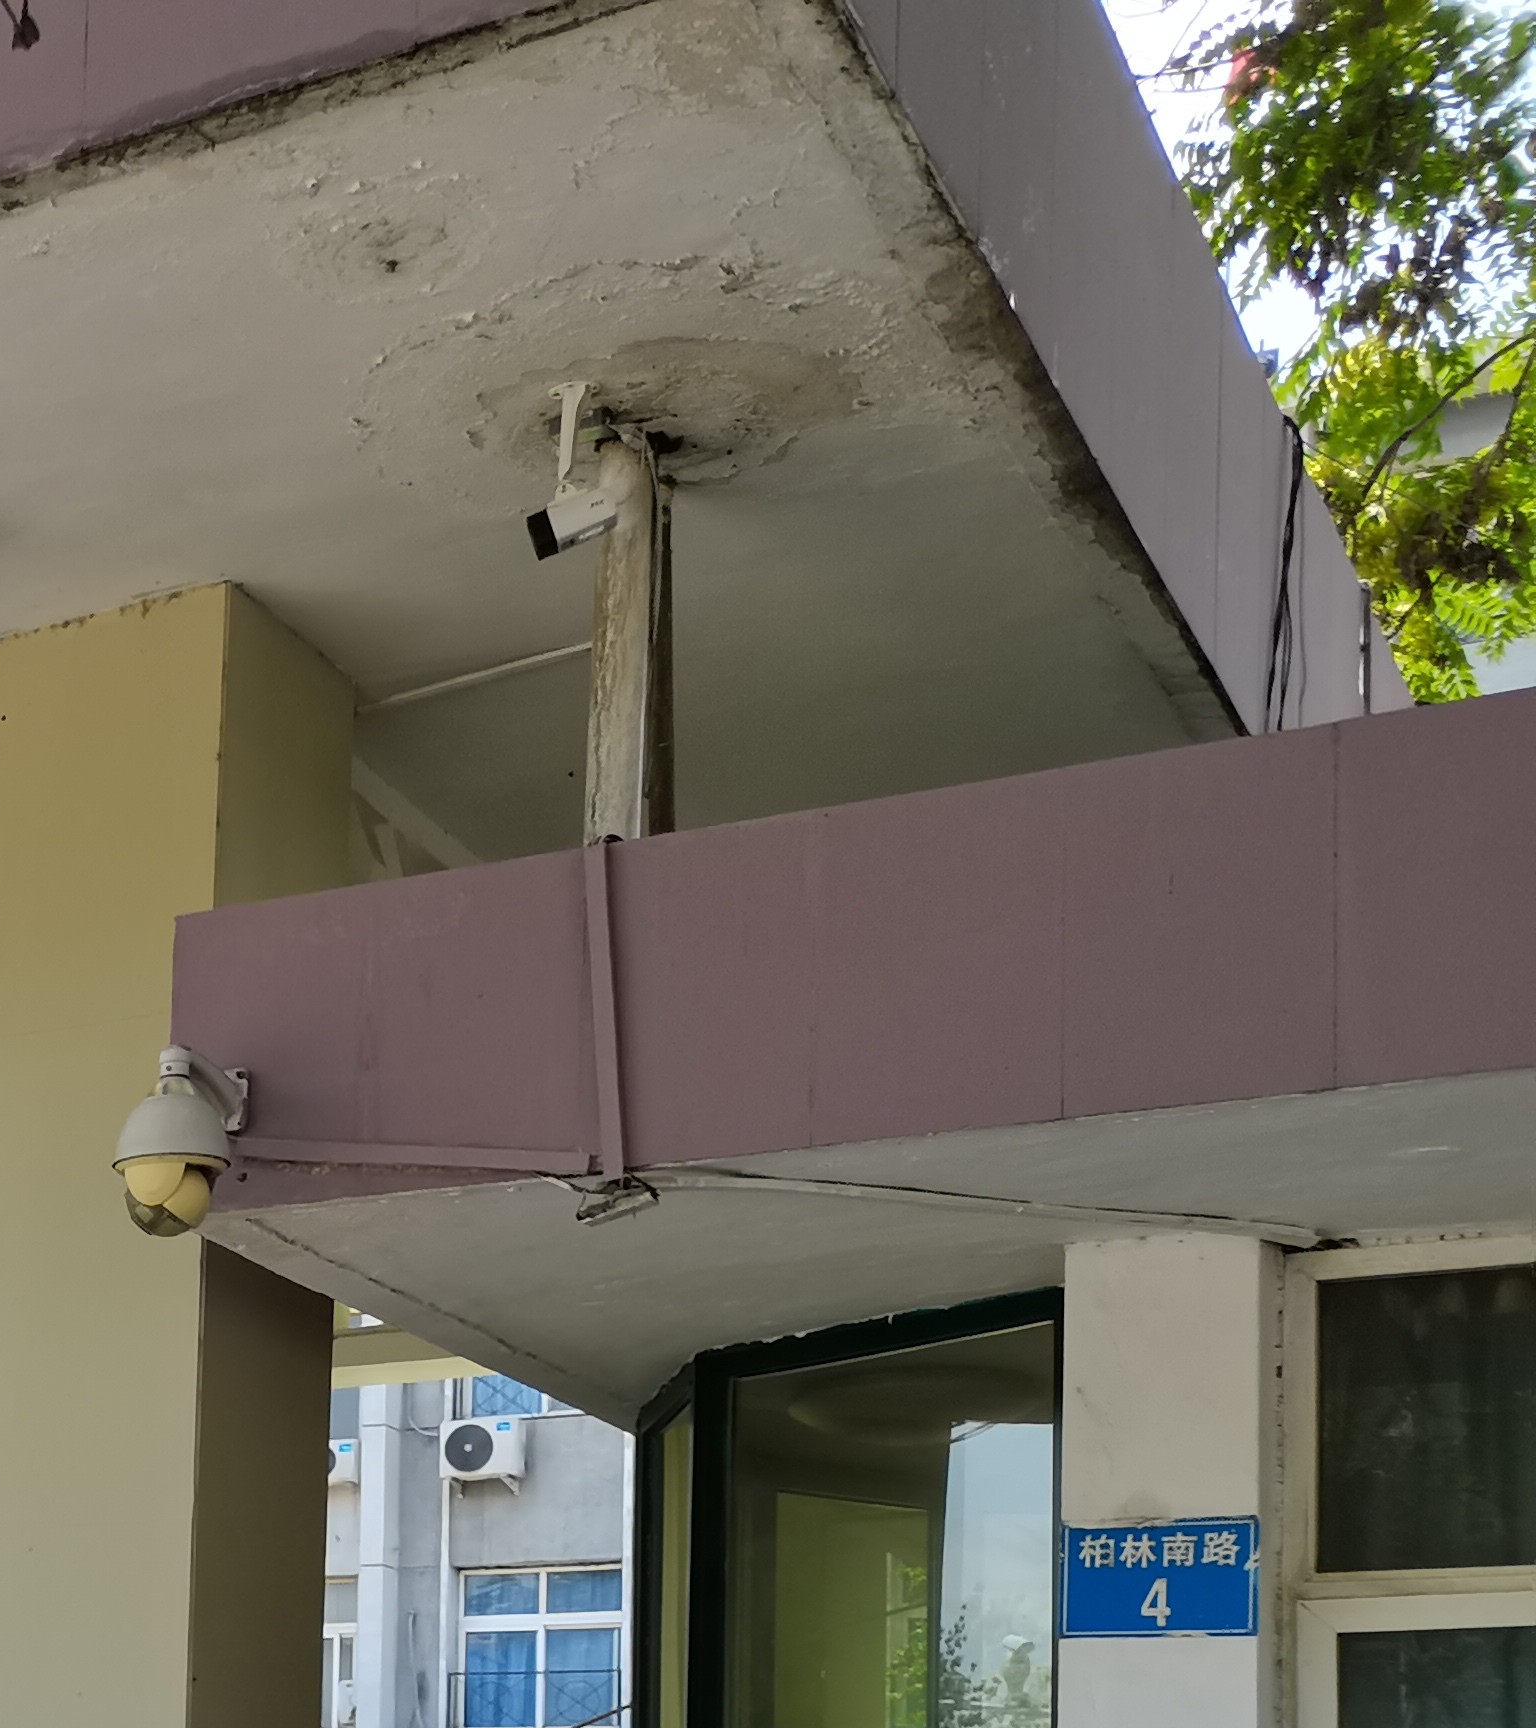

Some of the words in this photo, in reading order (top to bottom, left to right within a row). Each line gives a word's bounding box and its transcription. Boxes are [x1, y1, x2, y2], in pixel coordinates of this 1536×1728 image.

[1078, 1528, 1242, 1568] 柏林南路
[1140, 1577, 1172, 1627] 4
